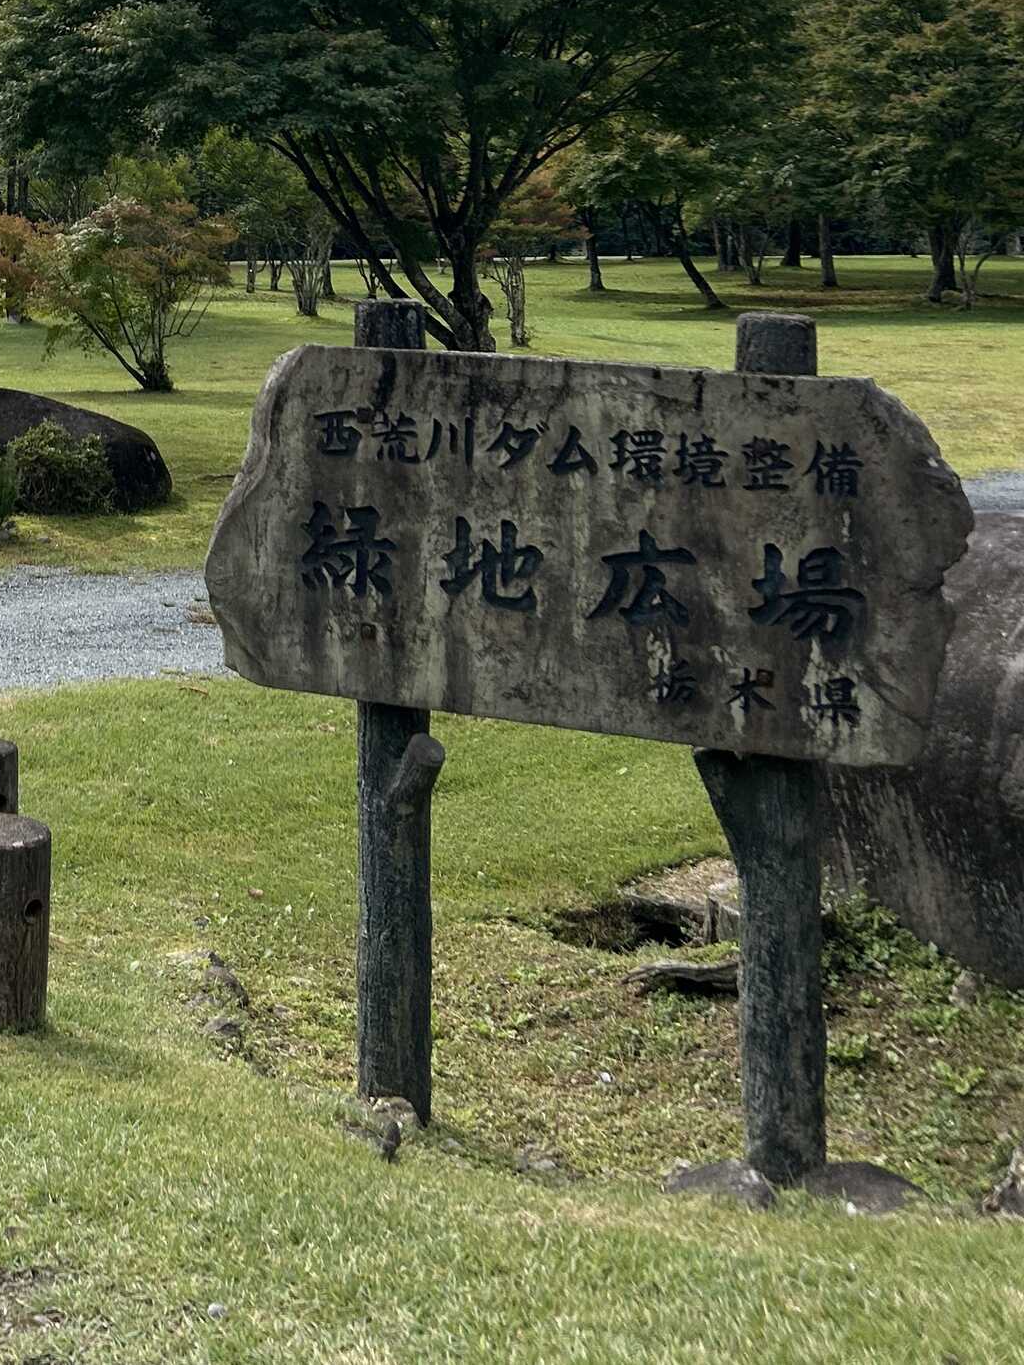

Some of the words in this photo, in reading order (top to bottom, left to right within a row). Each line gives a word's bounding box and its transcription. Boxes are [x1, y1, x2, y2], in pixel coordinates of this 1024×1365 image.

[312, 408, 865, 500] 西荒川ダム環境整備
[300, 500, 868, 644] 緑地広場
[650, 661, 861, 728] 栃木県
